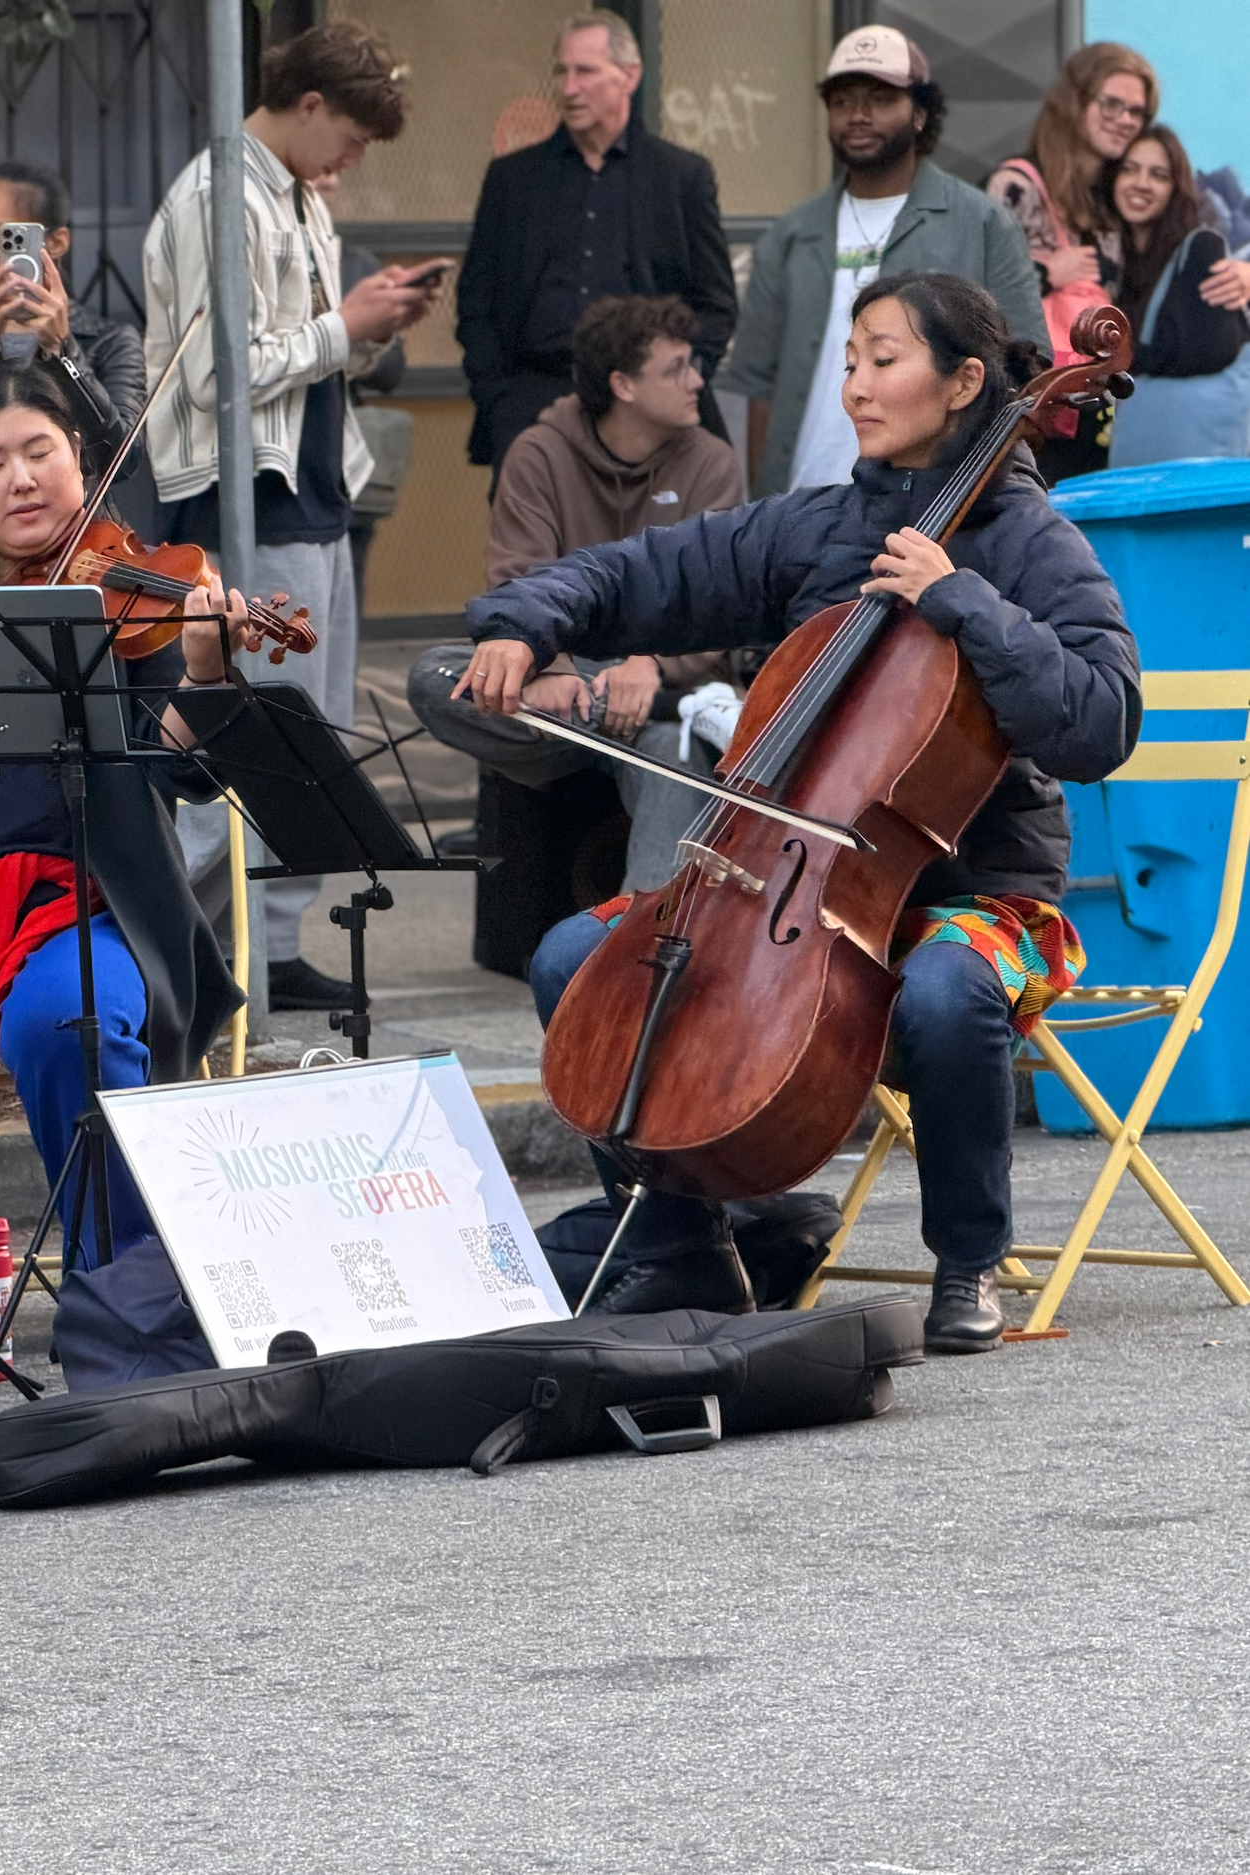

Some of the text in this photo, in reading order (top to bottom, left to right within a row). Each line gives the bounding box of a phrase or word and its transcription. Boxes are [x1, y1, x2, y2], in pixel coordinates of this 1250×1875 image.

[216, 1132, 428, 1193] MUSICIANS of the
[500, 1298, 535, 1313] Venmo
[368, 1315, 418, 1333] Donations
[234, 1336, 254, 1352] Our
